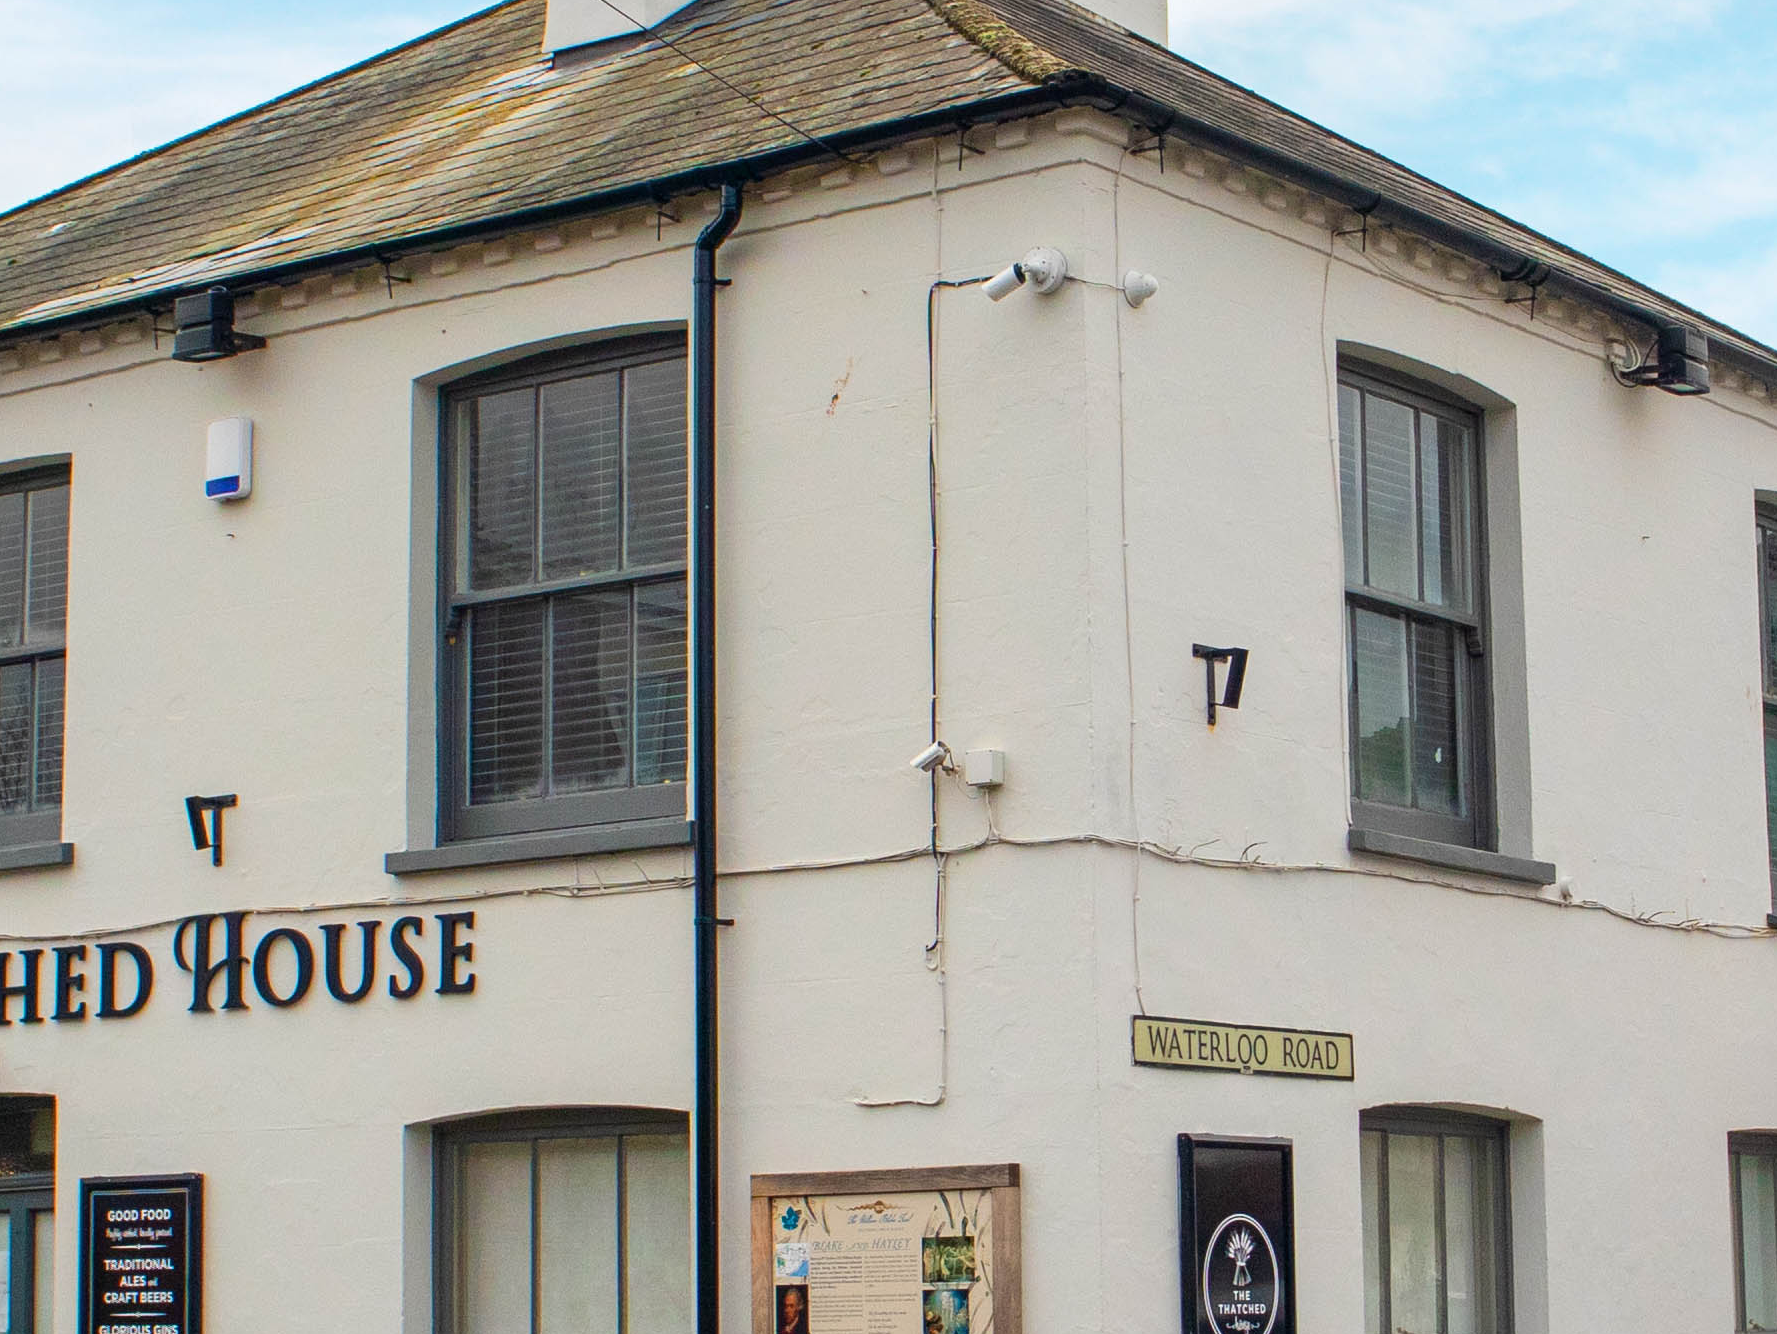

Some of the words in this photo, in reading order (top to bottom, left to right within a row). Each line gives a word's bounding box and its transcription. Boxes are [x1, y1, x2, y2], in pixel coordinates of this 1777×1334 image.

[174, 911, 477, 1012] HOUSE
[1147, 1025, 1268, 1065] WATERLOO
[1283, 1037, 1339, 1070] ROAD
[106, 1210, 139, 1222] GOOD
[140, 1209, 172, 1221] FOOD
[103, 1258, 175, 1271] TRADITIONAL
[120, 1275, 147, 1287] ALES
[104, 1292, 138, 1304] CRAFT
[139, 1291, 174, 1303] BEERS
[1232, 1290, 1251, 1301] THE
[1217, 1303, 1267, 1315] THATCHED
